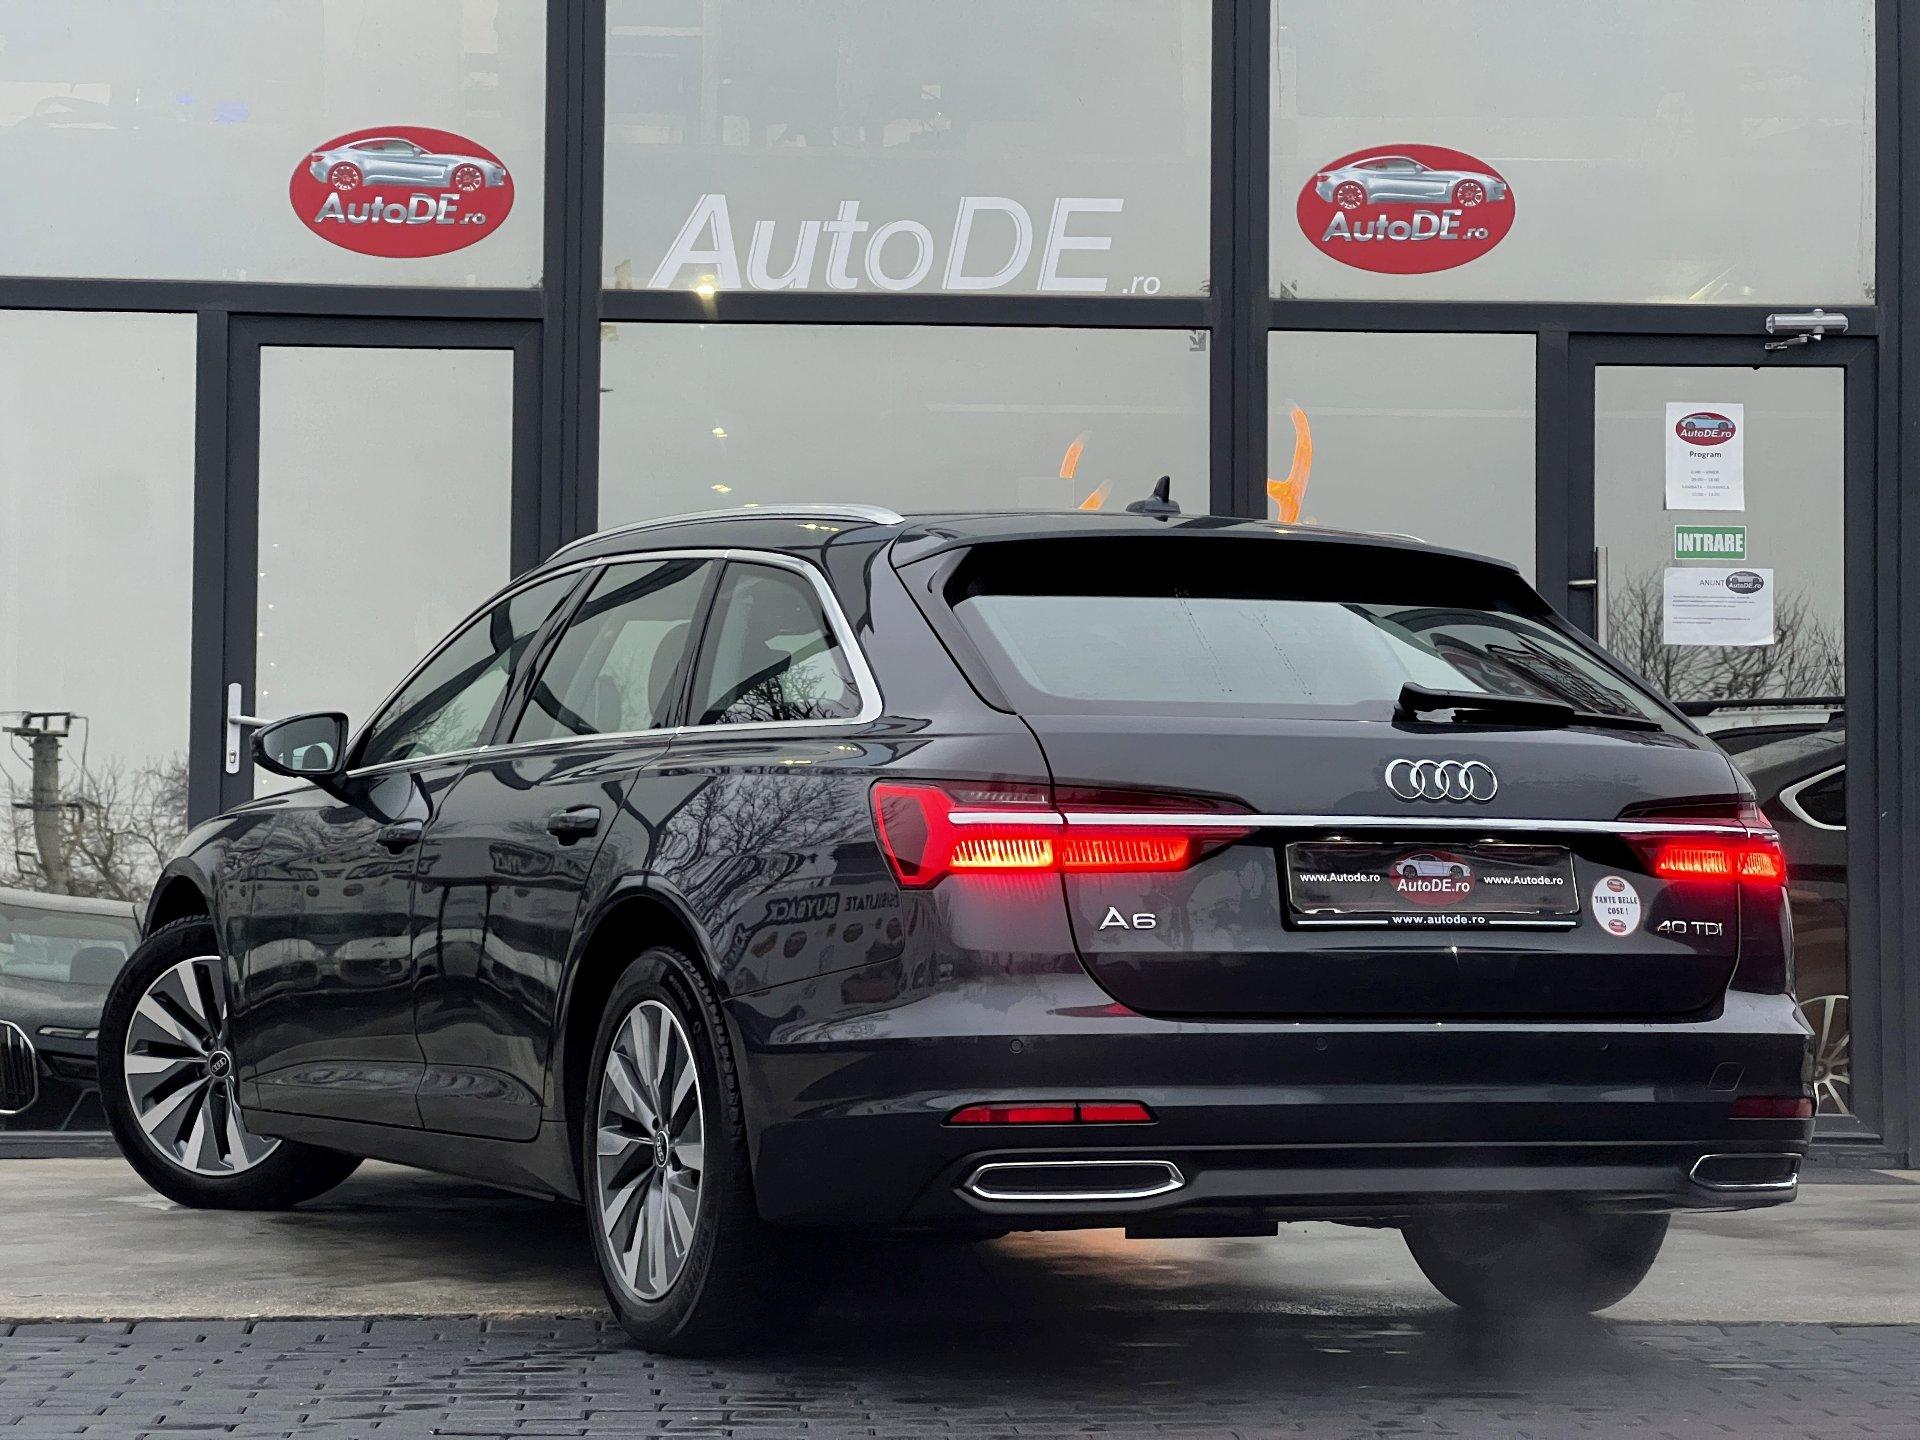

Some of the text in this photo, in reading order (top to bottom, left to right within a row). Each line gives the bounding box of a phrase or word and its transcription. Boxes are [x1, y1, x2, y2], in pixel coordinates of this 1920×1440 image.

[1680, 428, 1732, 438] AutoDE.ro
[1689, 451, 1722, 459] Program
[1677, 532, 1744, 552] INTRARE
[1299, 872, 1381, 883] www.Autode.ro
[1483, 875, 1564, 886] www.Autode.ro
[1396, 878, 1471, 893] AutoDE.ro
[1594, 895, 1638, 906] TANTE BELLE
[1098, 906, 1157, 930] A6
[1392, 914, 1486, 925] www.autode.ro
[1657, 920, 1723, 936] 40 TDI
